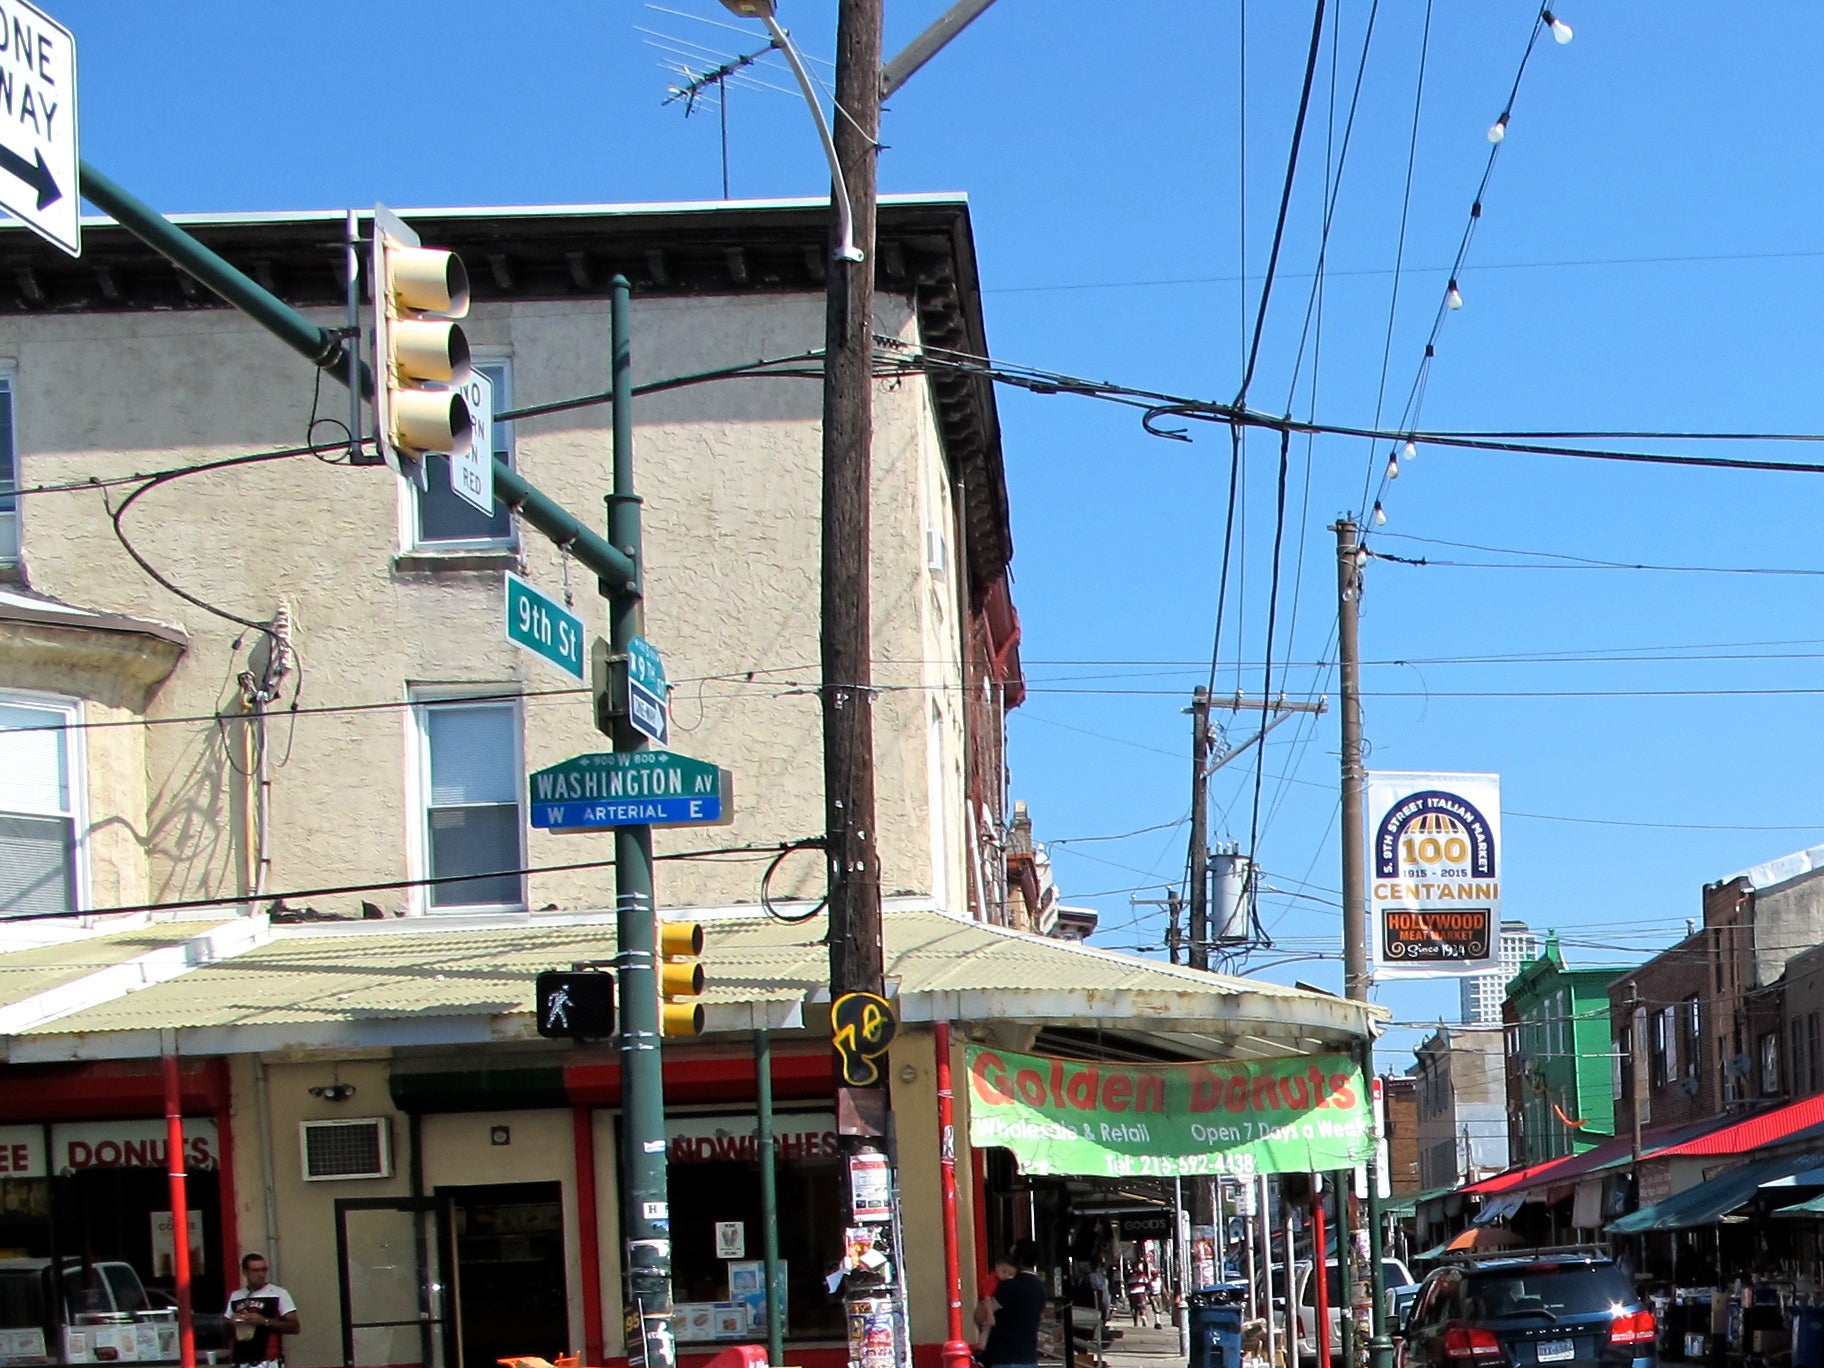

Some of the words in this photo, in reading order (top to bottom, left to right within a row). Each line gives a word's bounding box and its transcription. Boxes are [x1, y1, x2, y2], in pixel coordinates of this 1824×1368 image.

[463, 467, 481, 495] RED
[519, 596, 551, 646] 9th
[559, 620, 577, 662] St
[617, 753, 630, 766] W
[634, 754, 655, 764] 800
[537, 768, 682, 799] WASHINGTON
[695, 775, 712, 793] AV
[547, 807, 564, 824] W
[584, 804, 667, 821] ARTERIAL
[690, 800, 703, 818] E
[1386, 799, 1423, 832] STREET
[1427, 798, 1475, 823] ITALIAN
[1382, 833, 1394, 860] 9TH
[1403, 838, 1468, 865] 100
[1471, 823, 1488, 873] MARKET
[1403, 869, 1427, 878] 1915
[1440, 869, 1468, 877] 2015
[1373, 883, 1498, 900] CENT'ANNI
[1389, 914, 1483, 930] HOLLYWOOD
[1400, 931, 1429, 940] MEAT
[1431, 931, 1473, 940] MARKET
[1407, 943, 1439, 957] Since
[973, 1052, 1165, 1113] Golden
[1188, 1065, 1356, 1113] Donuts
[976, 1118, 1079, 1140] Wholesale
[1084, 1122, 1096, 1141] &
[1100, 1122, 1151, 1142] Retail
[1191, 1124, 1240, 1145] Open
[1243, 1122, 1252, 1141] 7
[1259, 1122, 1298, 1144] Days
[1303, 1126, 1314, 1138] a
[1317, 1120, 1366, 1138] Week
[1124, 1218, 1167, 1231] GOODS
